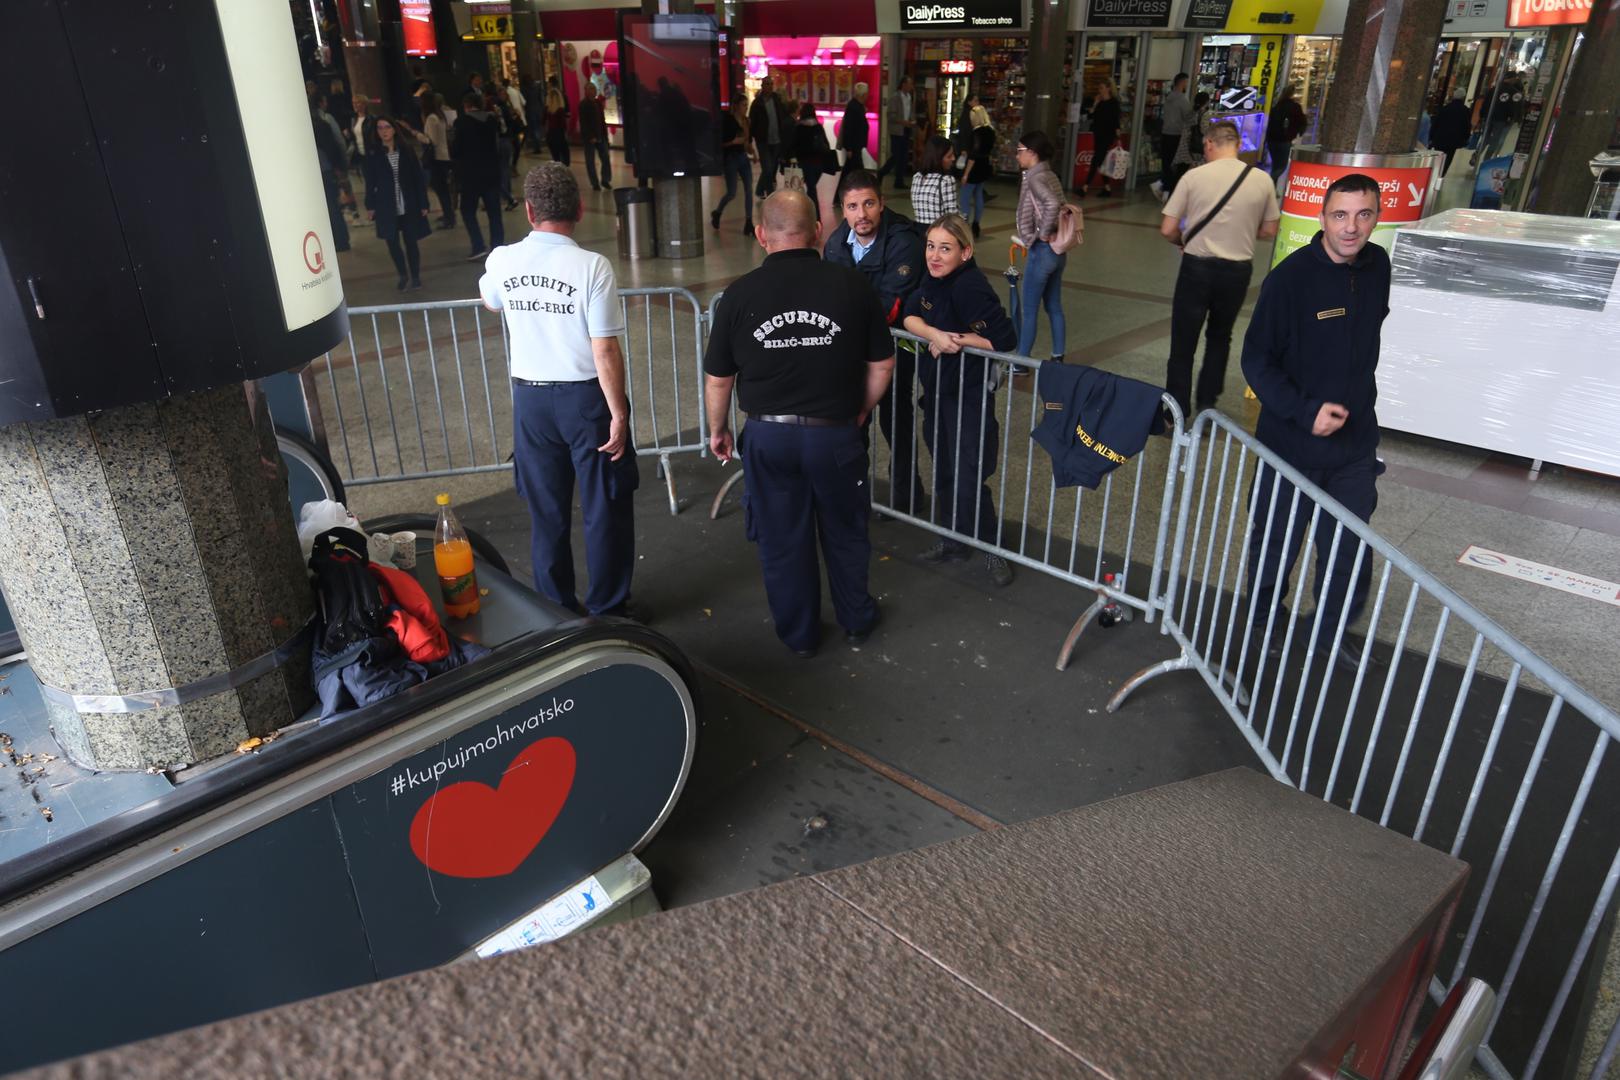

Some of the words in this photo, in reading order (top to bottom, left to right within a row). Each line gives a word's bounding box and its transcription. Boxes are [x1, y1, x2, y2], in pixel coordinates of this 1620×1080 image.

[906, 4, 965, 21] DailyPress
[971, 17, 996, 25] Tobacco
[997, 17, 1013, 25] shop
[1094, 0, 1168, 14] DailyPress
[1292, 175, 1330, 189] ZAKORAČI
[1379, 181, 1400, 192] EPŠI
[503, 275, 577, 297] SECURITY
[752, 310, 842, 342] SECURITY
[1093, 442, 1127, 465] OMETNI
[391, 696, 575, 796] #kupujmohrvatsko
